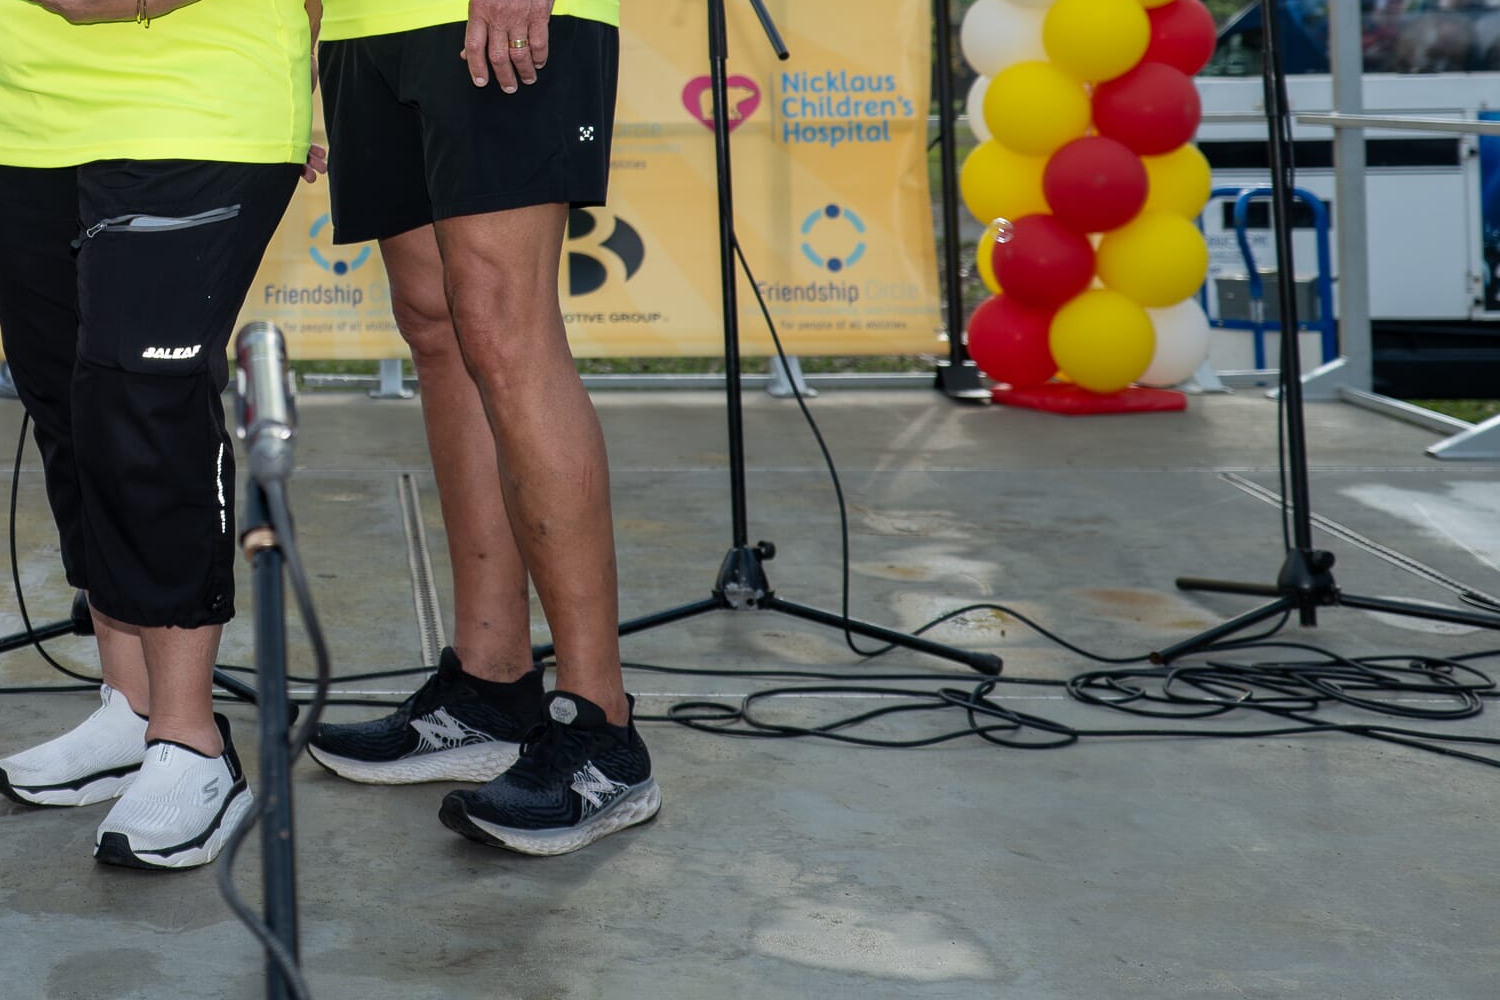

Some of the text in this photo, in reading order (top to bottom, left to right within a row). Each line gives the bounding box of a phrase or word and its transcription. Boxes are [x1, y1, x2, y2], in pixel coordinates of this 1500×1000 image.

[781, 70, 896, 94] Nicklaus
[781, 94, 914, 119] Children's
[782, 119, 891, 148] Hospital
[264, 283, 363, 308] Friendship
[756, 280, 860, 305] Friendship
